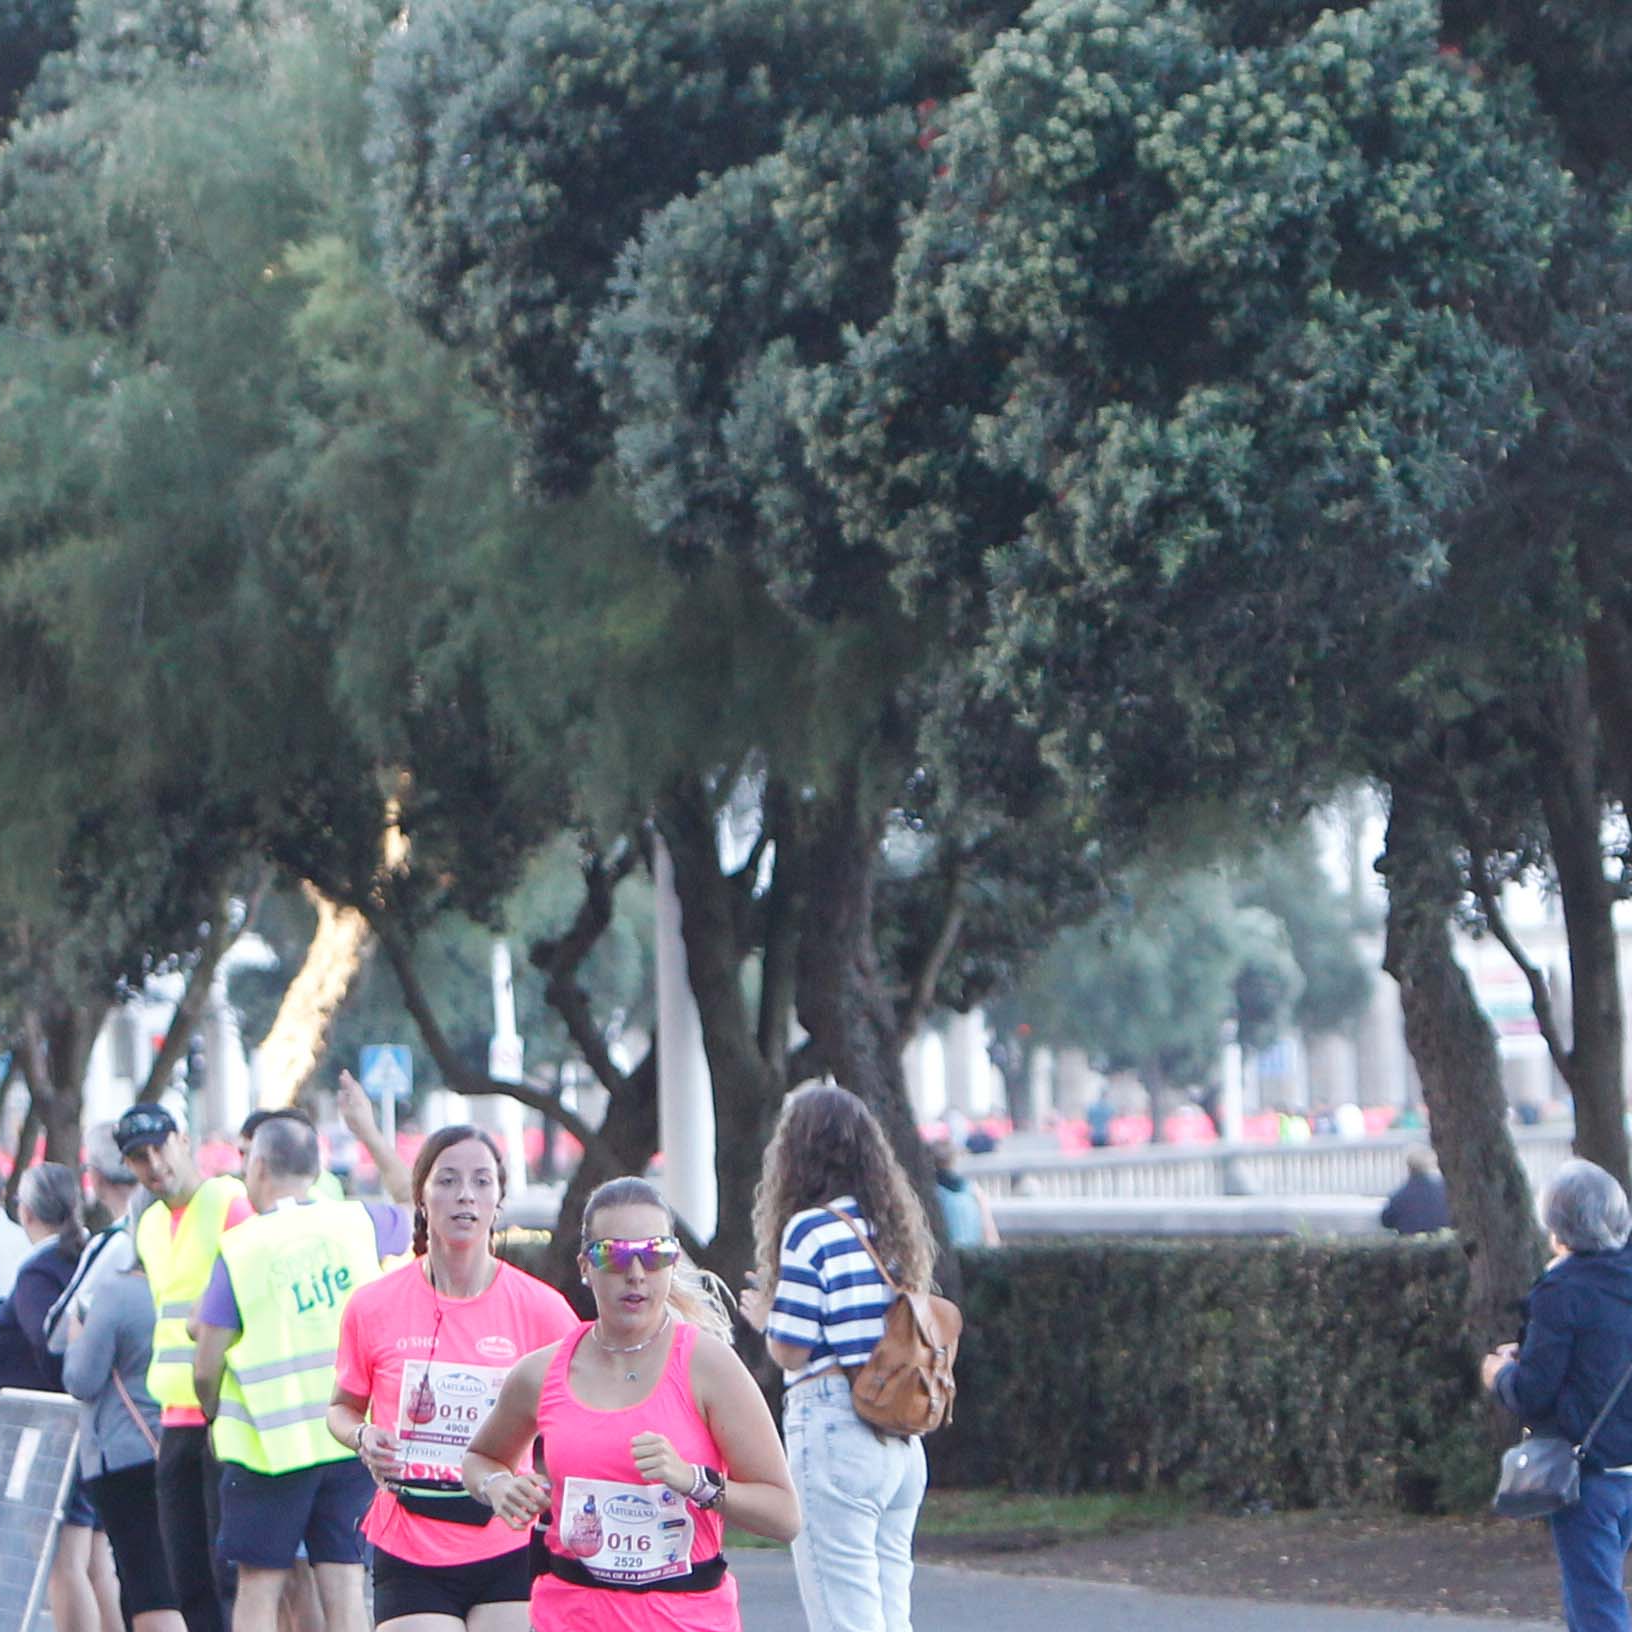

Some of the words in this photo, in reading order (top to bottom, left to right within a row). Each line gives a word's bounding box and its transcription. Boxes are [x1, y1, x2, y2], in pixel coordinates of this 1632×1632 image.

[290, 1265, 352, 1314] Life
[439, 1404, 478, 1421] 016
[608, 1503, 655, 1517] ASTURIANA
[607, 1532, 652, 1551] 016
[614, 1556, 643, 1568] 2529
[625, 1571, 636, 1580] LA
